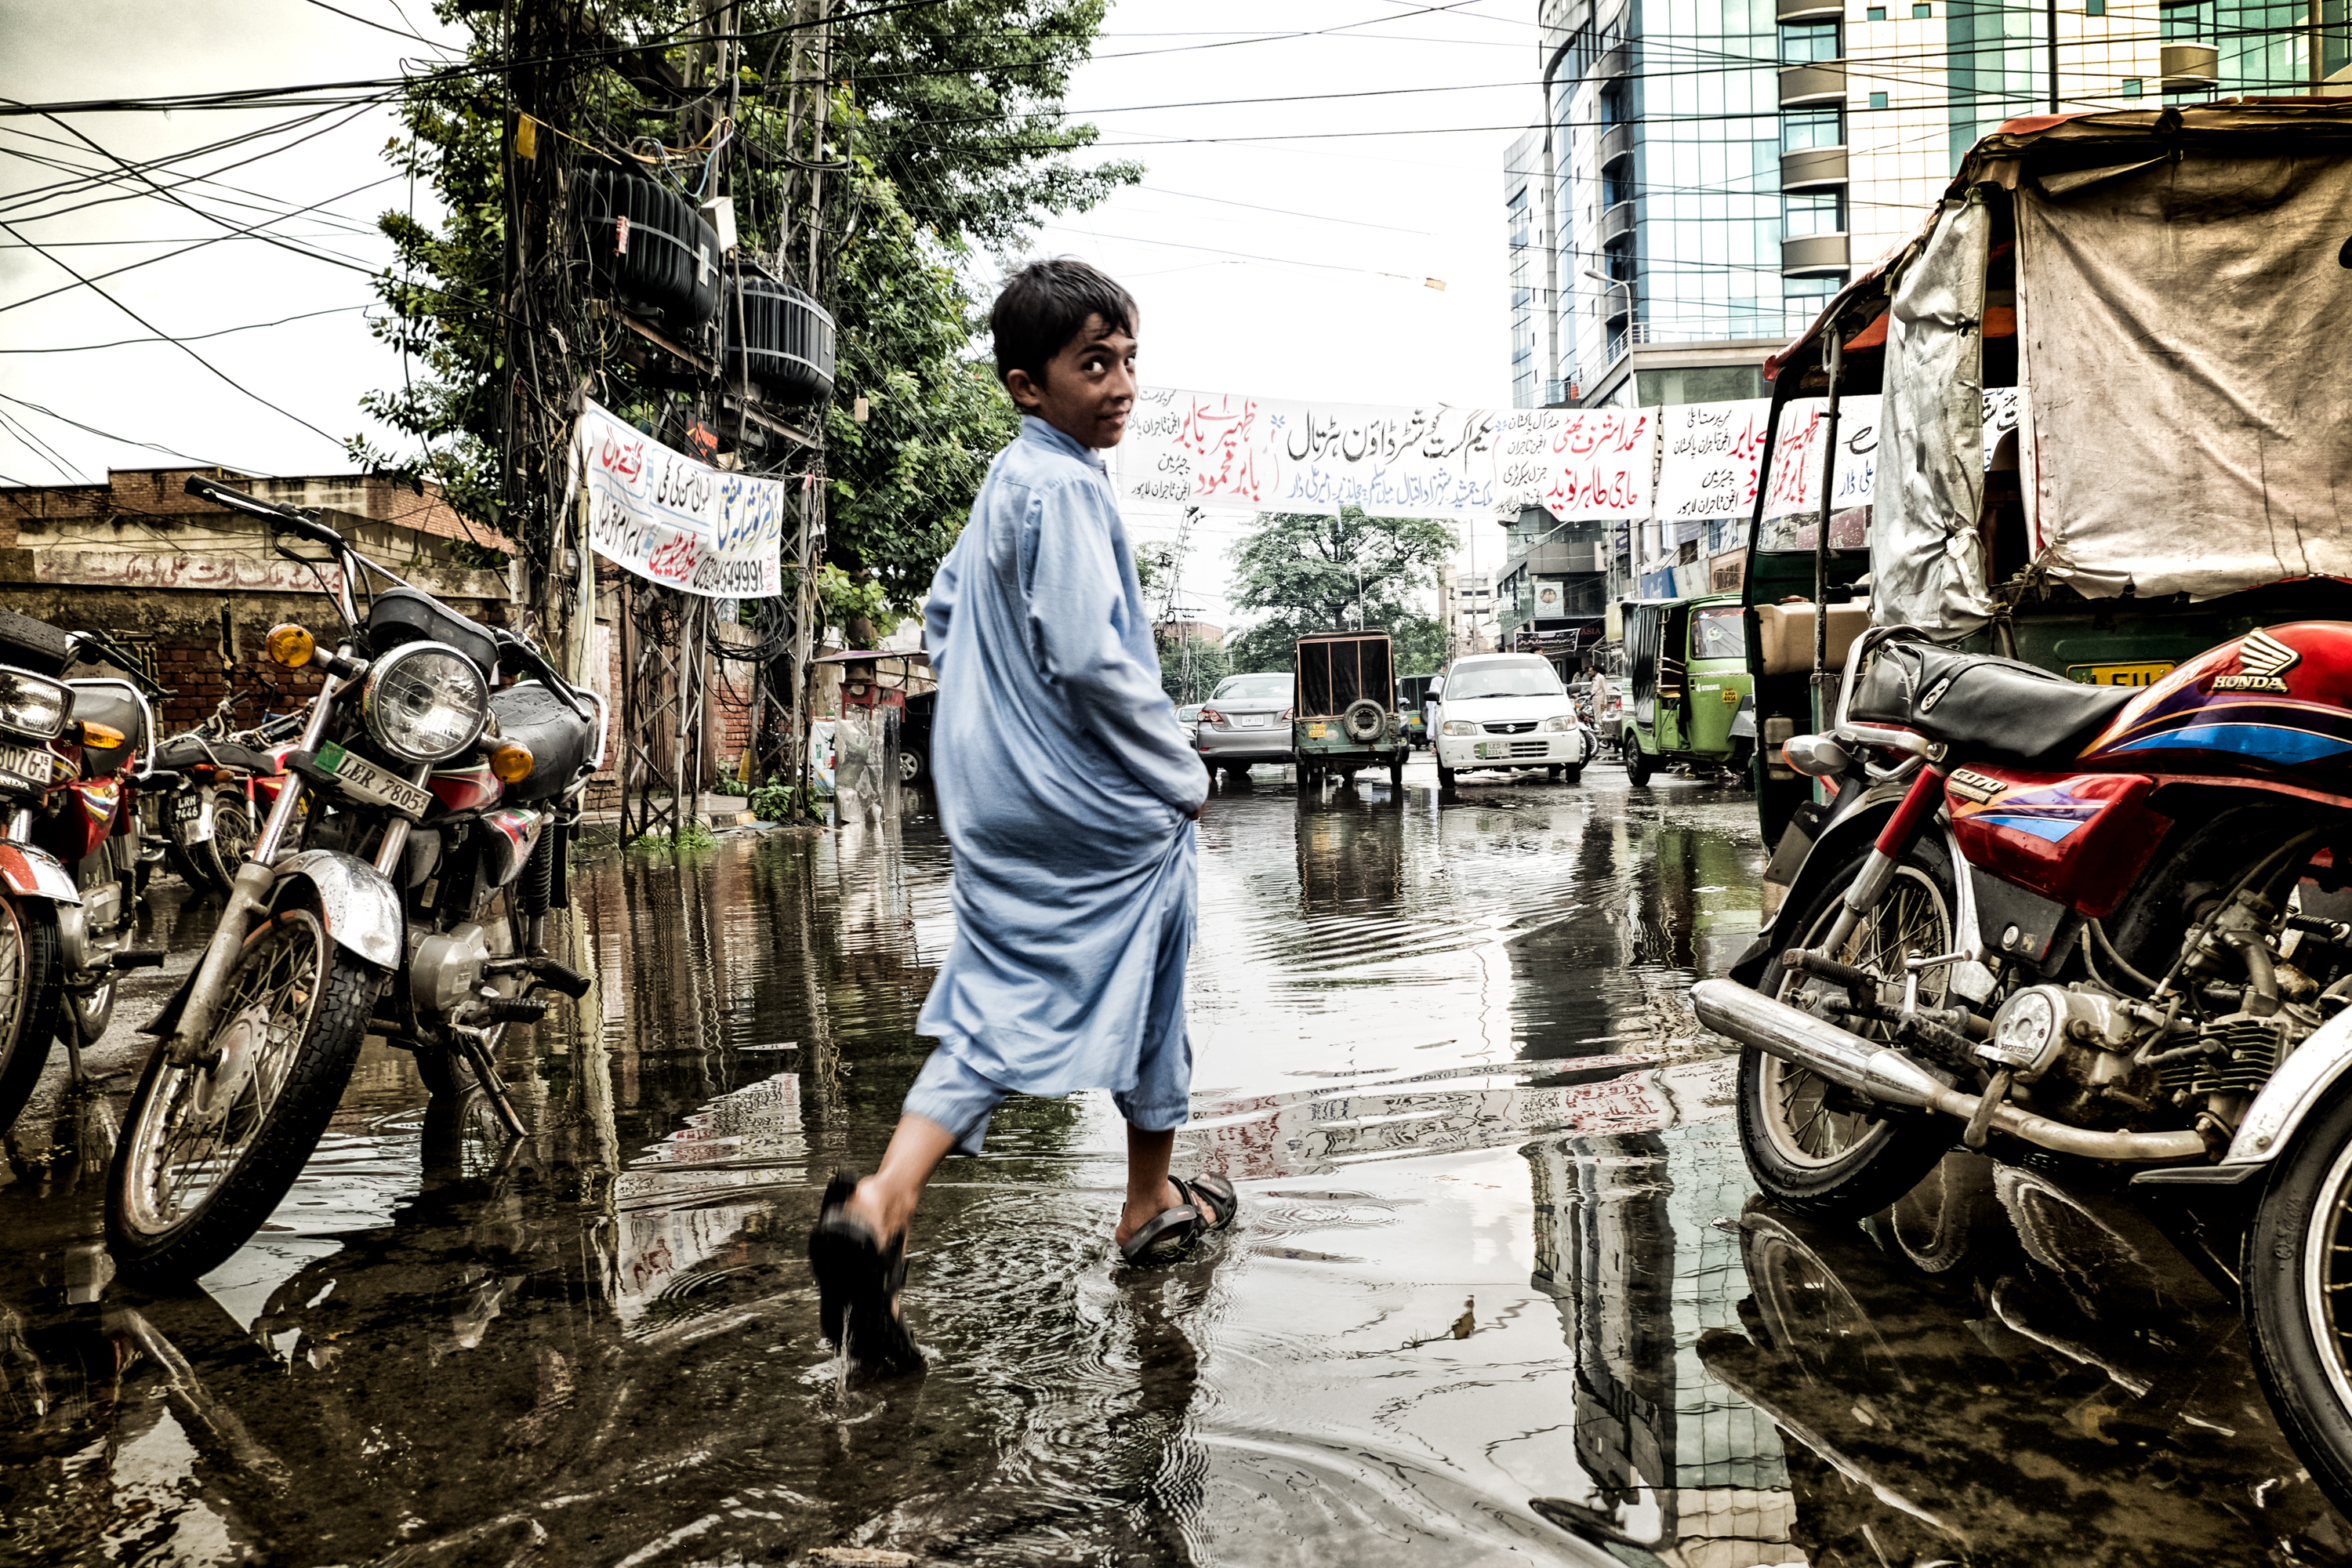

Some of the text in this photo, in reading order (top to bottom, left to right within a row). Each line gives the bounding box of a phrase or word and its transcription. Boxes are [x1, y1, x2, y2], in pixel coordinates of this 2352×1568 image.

[2212, 675, 2288, 692] HONDA
[38, 768, 46, 780] A
[0, 775, 31, 791] NDA
[335, 757, 376, 789] LER
[379, 779, 423, 811] 7805
[178, 795, 197, 809] LRH
